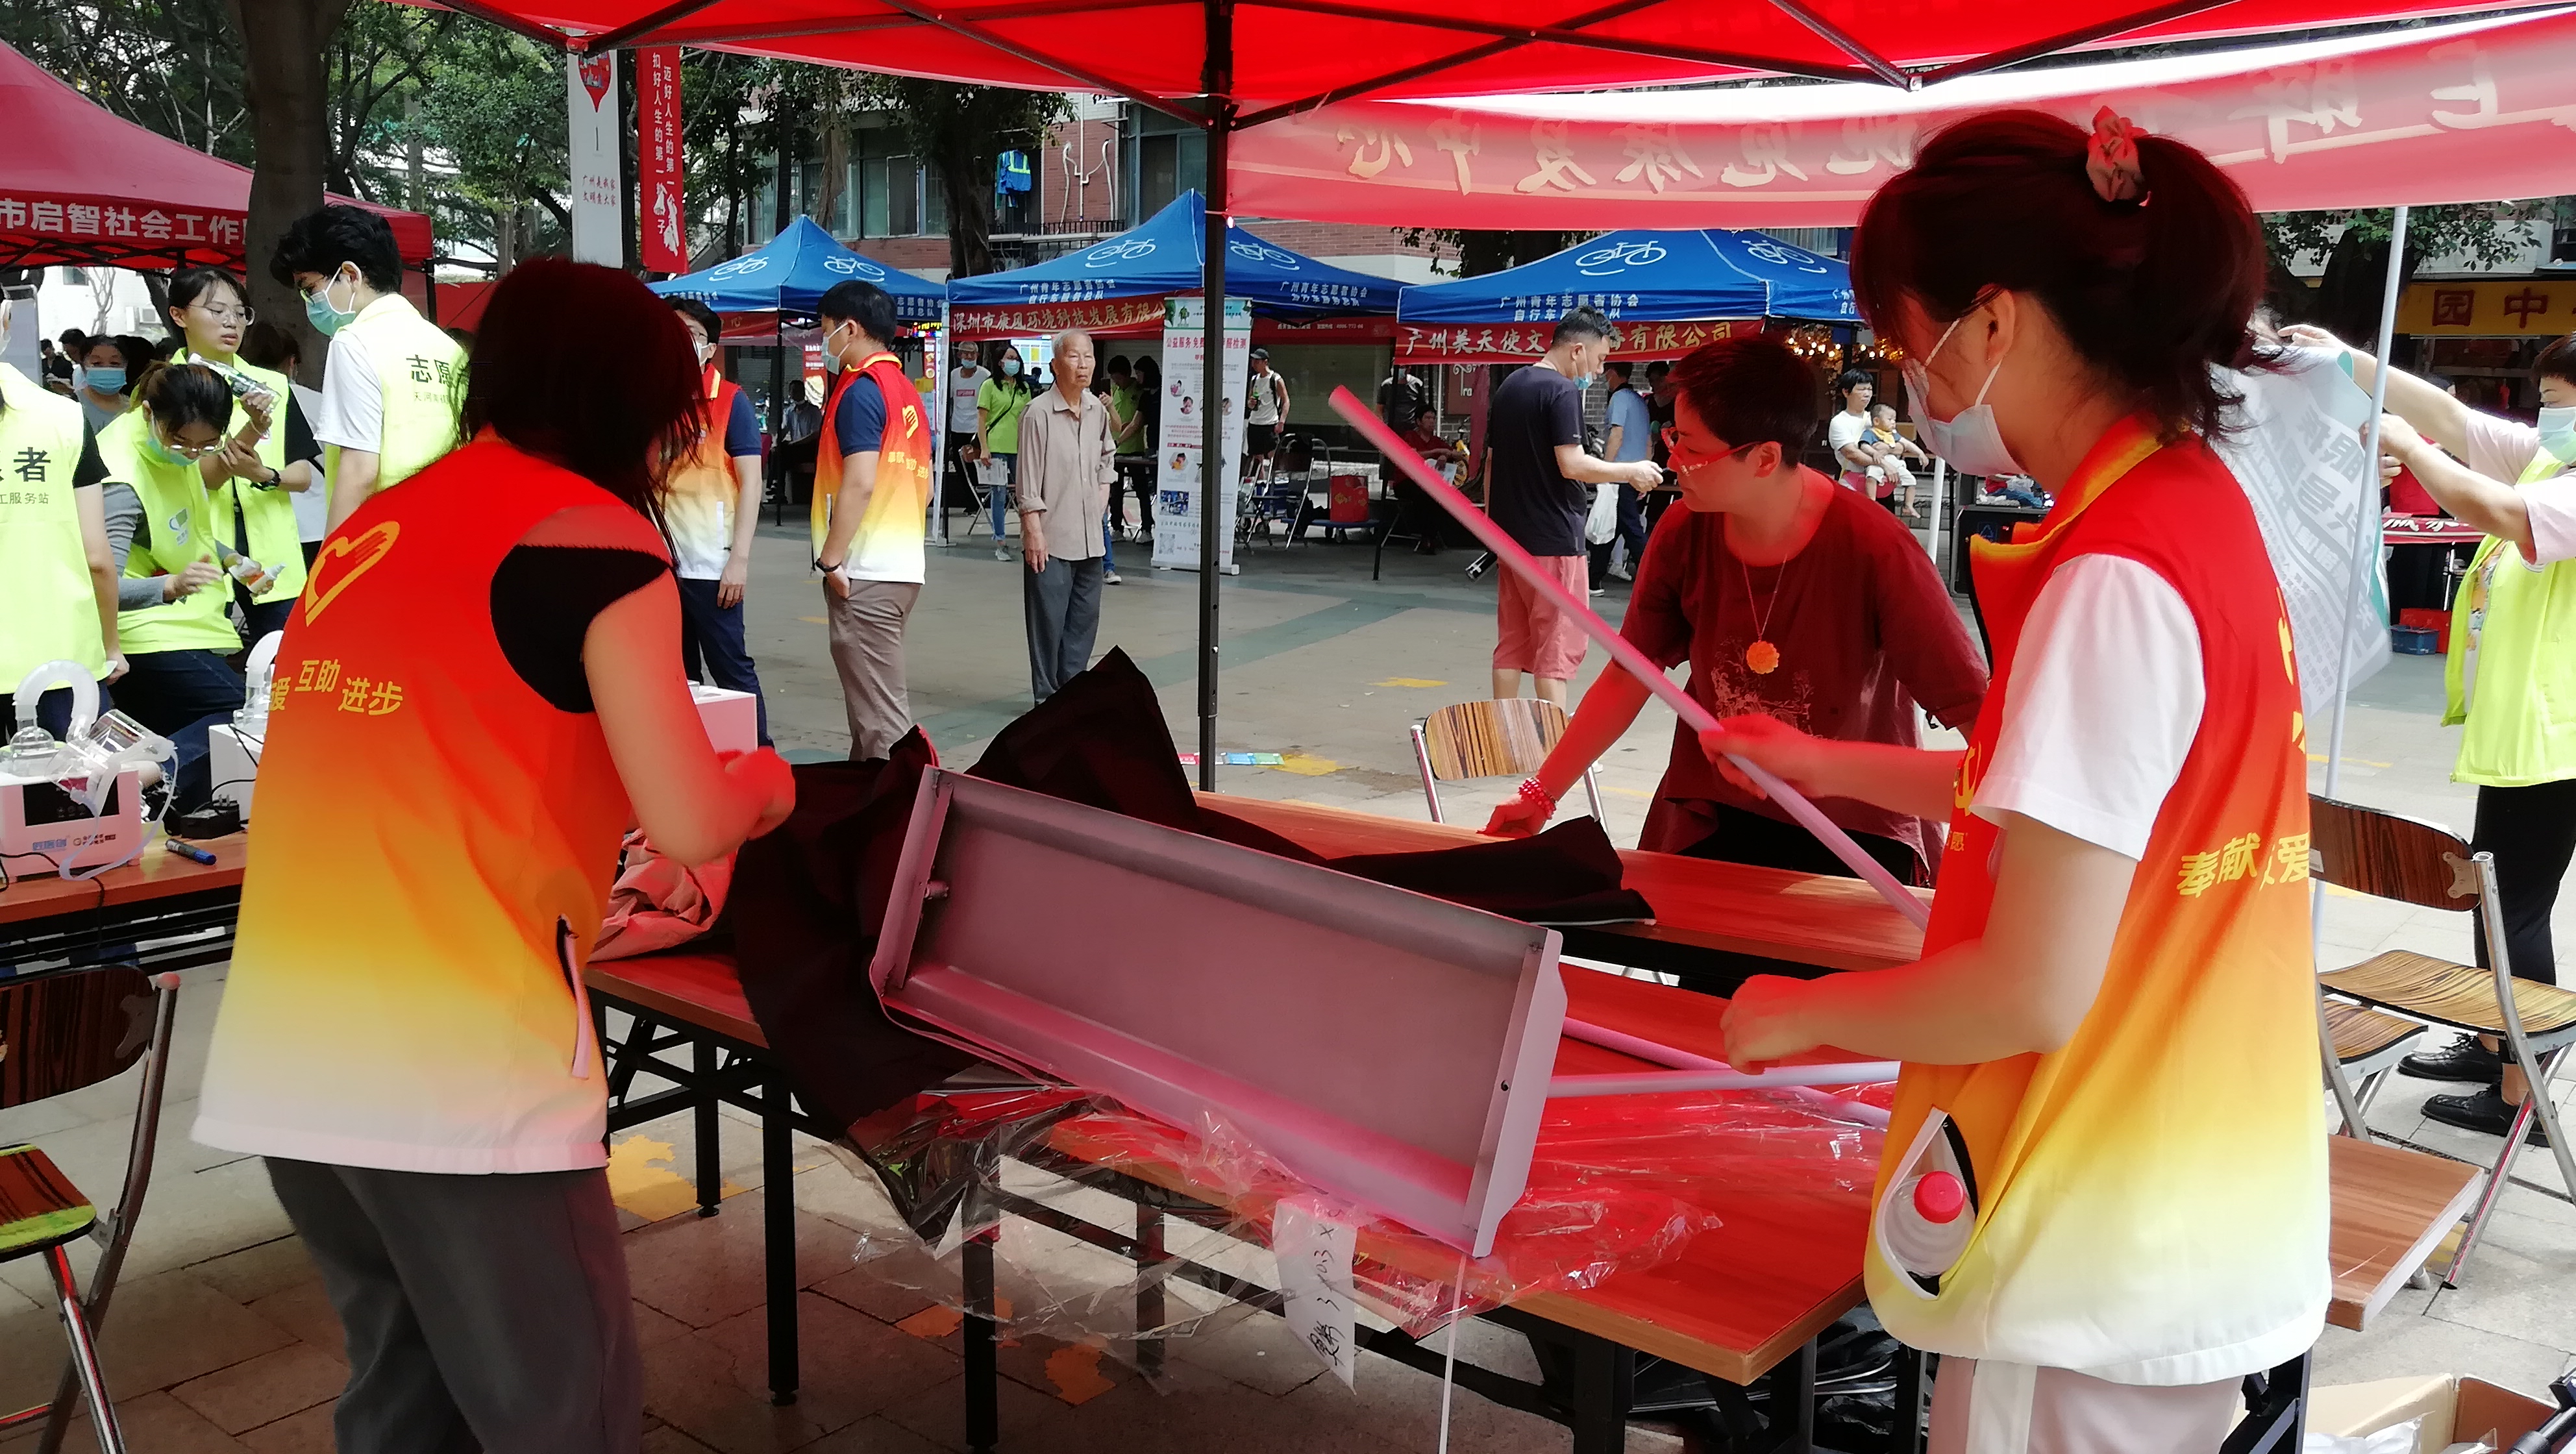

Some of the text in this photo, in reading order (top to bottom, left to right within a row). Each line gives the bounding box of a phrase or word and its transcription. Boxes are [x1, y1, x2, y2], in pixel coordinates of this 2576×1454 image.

[0, 197, 248, 245] 市启智社会工作
[2432, 286, 2576, 329] 园中
[0, 447, 51, 482] 者
[295, 658, 341, 693] 互助
[337, 677, 403, 716] 进步
[2177, 832, 2261, 898] 奉献
